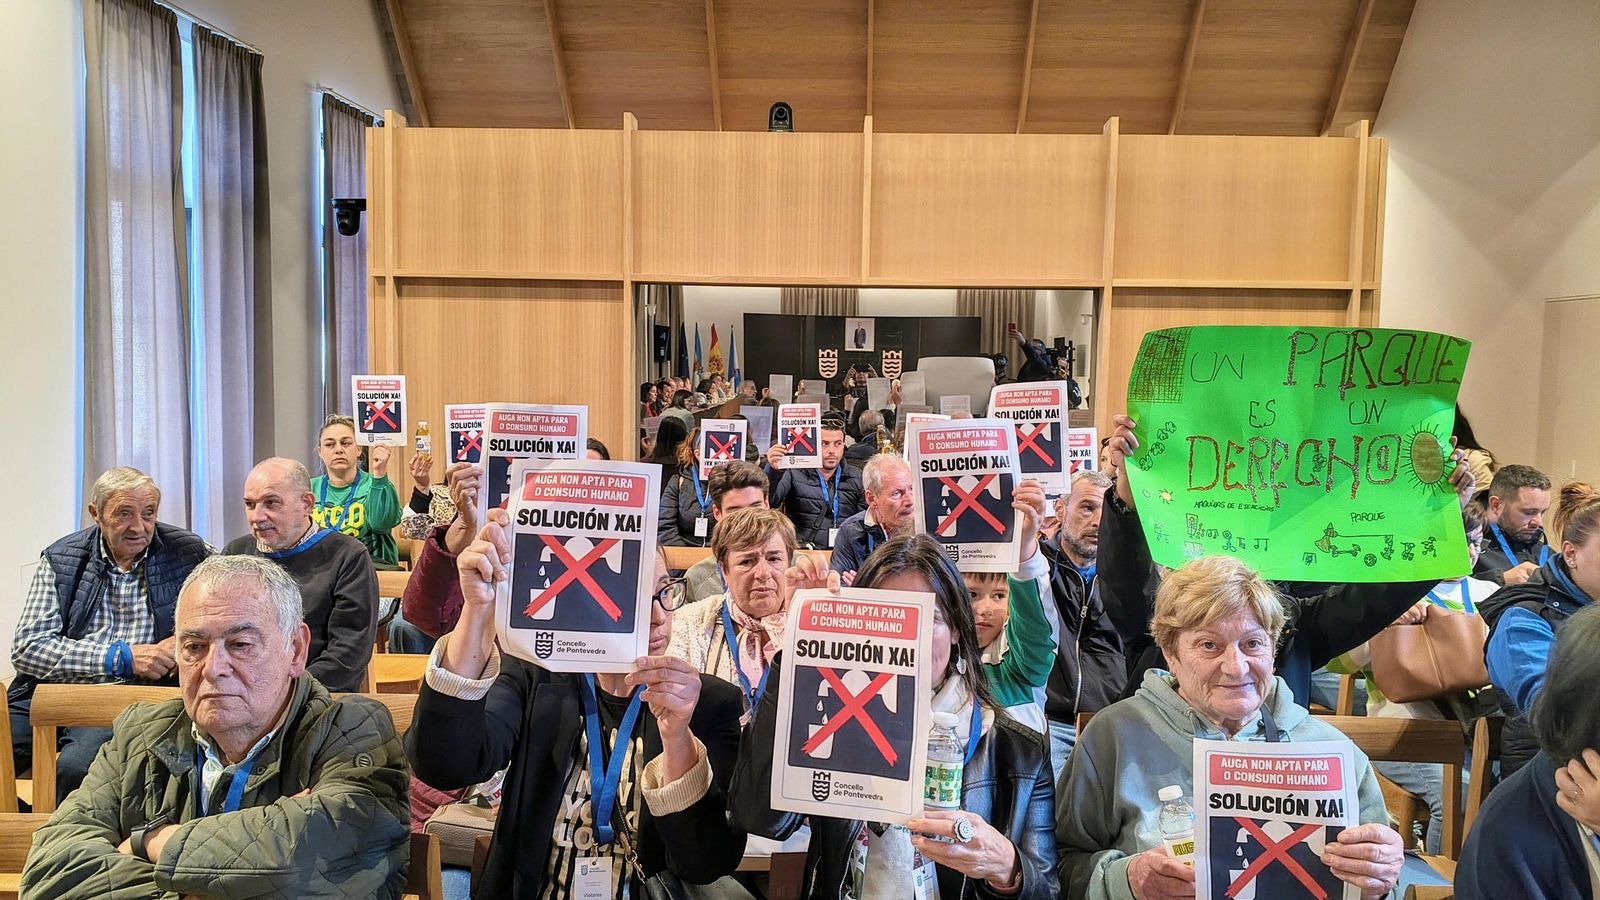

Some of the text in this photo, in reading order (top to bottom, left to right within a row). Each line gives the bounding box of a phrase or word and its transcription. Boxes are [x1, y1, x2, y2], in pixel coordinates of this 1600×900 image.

[1190, 329, 1468, 400] UN PARQUE
[357, 391, 400, 400] SOLUCIÓN XA!
[516, 414, 530, 422] NON
[551, 416, 568, 424] PARA
[1045, 408, 1060, 419] XA!
[1248, 399, 1388, 429] ES UN
[450, 421, 482, 430] SOLUCIÓN
[500, 422, 566, 433] O CONSUMO HUMANO
[781, 418, 807, 426] SOLUCIÓN
[926, 430, 998, 440] AUGA NON APTA PARA
[489, 437, 576, 454] SOLUCIÓN XA!
[936, 440, 970, 450] CONSUMO
[970, 440, 998, 448] HUMANO
[920, 454, 1010, 472] SOLUCIÓN XA!
[534, 475, 633, 489] AUGA NON APTA PARA
[535, 487, 629, 502] O CONSUMO HUMANO
[516, 507, 642, 532] SOLUCIÓN XA!
[1350, 512, 1386, 522] PARQUE
[810, 602, 906, 620] AUGA NON APTA PARA
[811, 616, 902, 633] O CONSUMO HUMANO
[796, 638, 915, 668] SOLUCIÓN XA!
[1220, 757, 1330, 771] AUGA NON APTA PARA
[1223, 771, 1328, 786] O CONSUMO HUMANO
[834, 781, 864, 791] Concello
[843, 790, 884, 800] Pontevedra
[1209, 793, 1344, 818] SOLUCIÓN XA!
[1172, 841, 1194, 857] AUG
